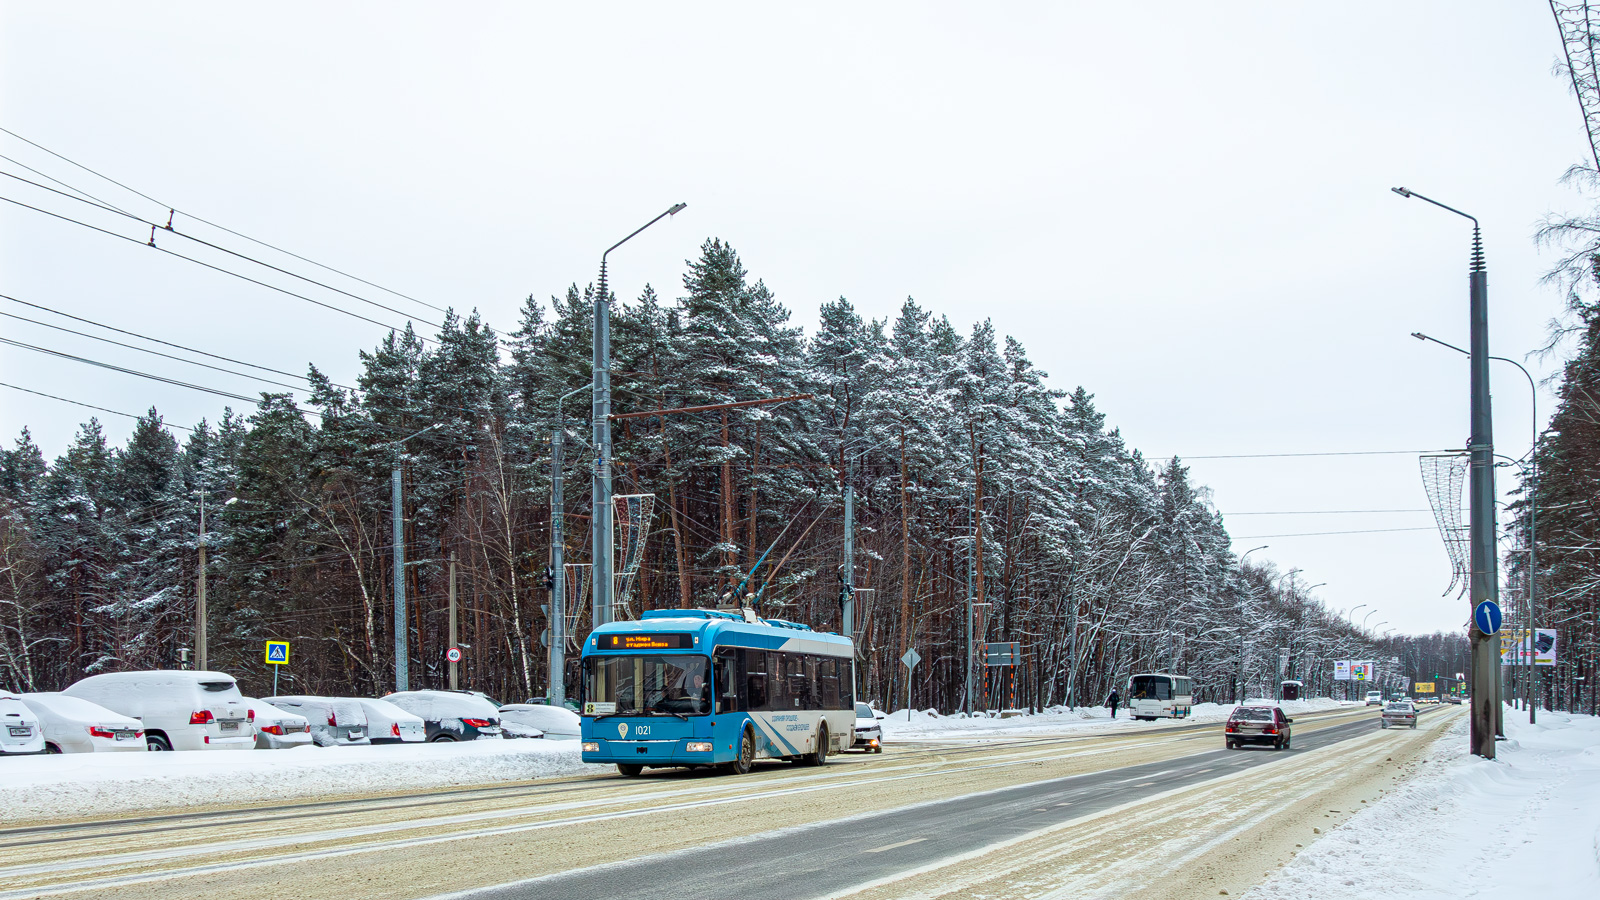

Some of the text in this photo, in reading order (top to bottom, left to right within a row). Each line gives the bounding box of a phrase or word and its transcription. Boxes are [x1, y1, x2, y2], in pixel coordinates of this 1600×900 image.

[612, 636, 619, 645] 8
[586, 703, 594, 714] 8
[635, 725, 651, 735] 1021
